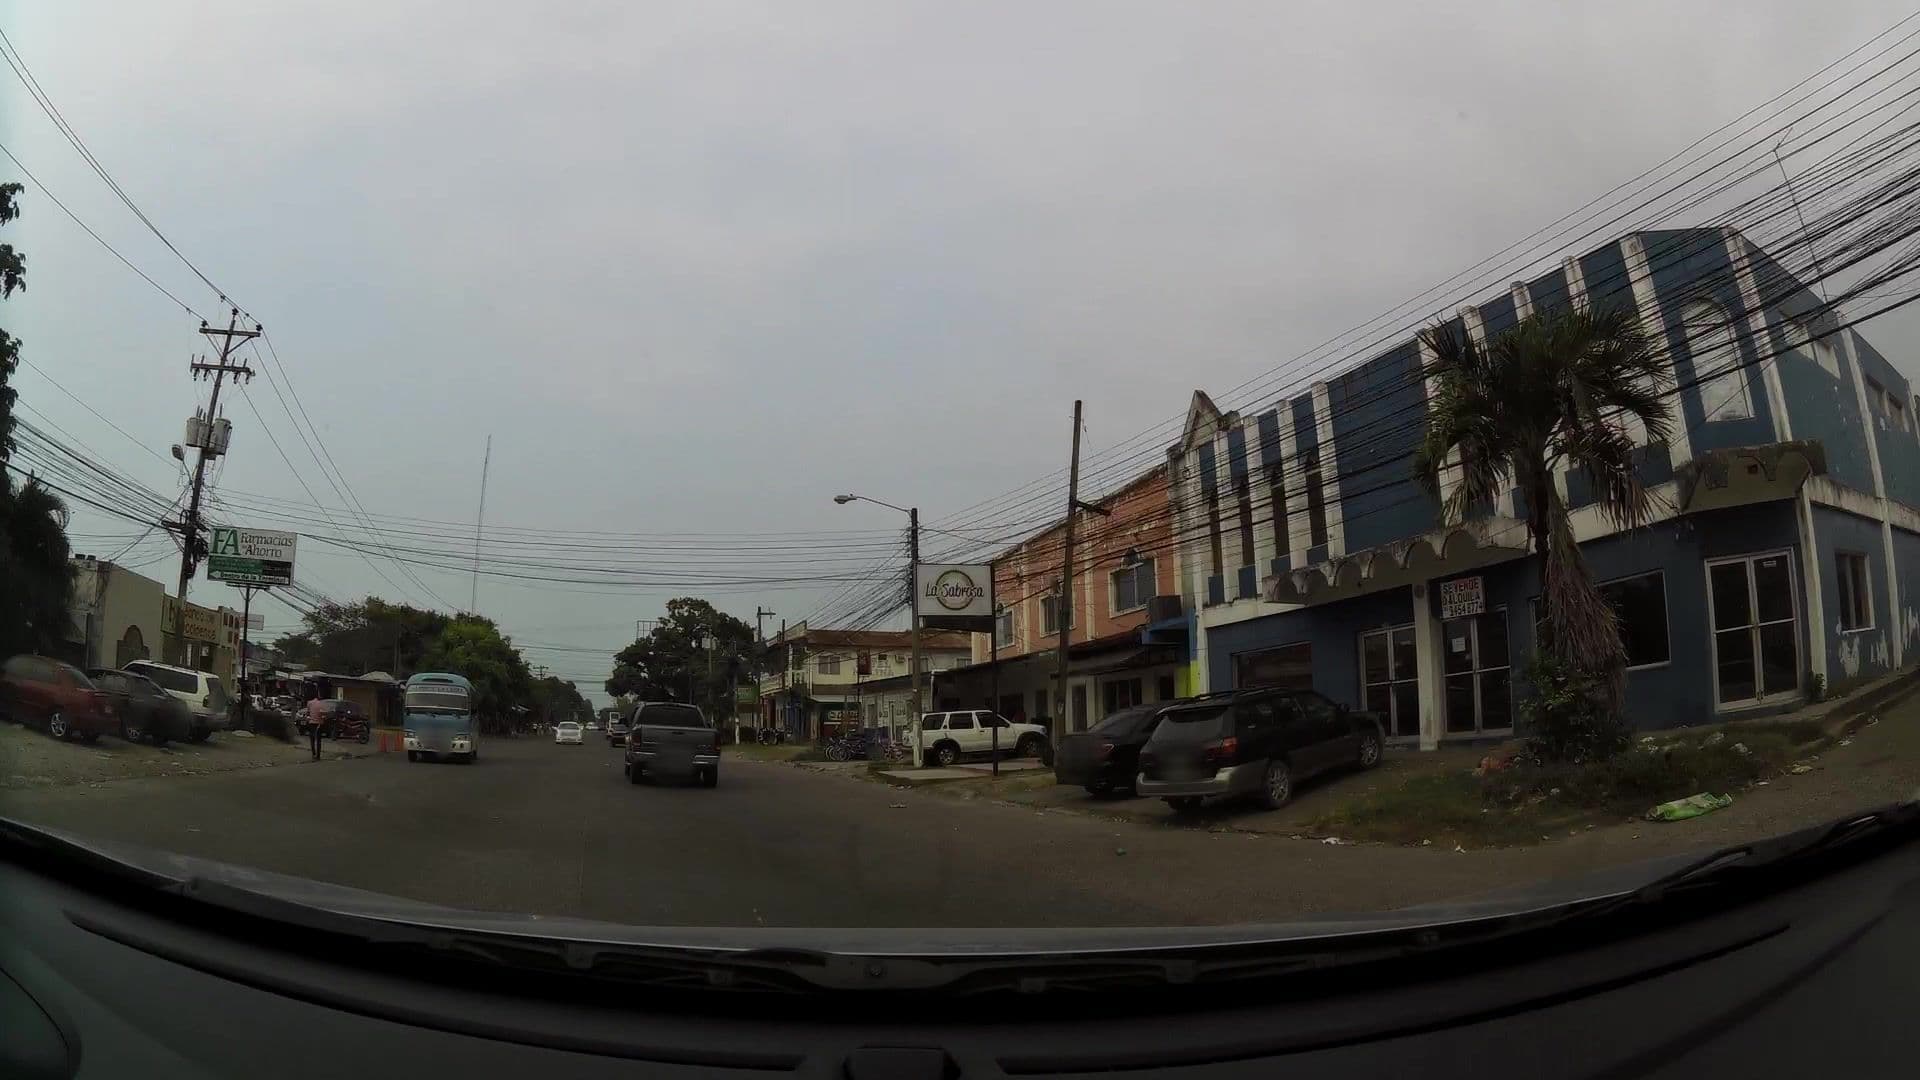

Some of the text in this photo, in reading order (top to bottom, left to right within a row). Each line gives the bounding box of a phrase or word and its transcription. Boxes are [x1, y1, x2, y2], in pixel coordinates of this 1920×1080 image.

[210, 528, 241, 555] FA
[240, 532, 293, 547] Farmacias
[245, 544, 282, 558] Ahorro
[925, 581, 984, 598] La Sabrosa
